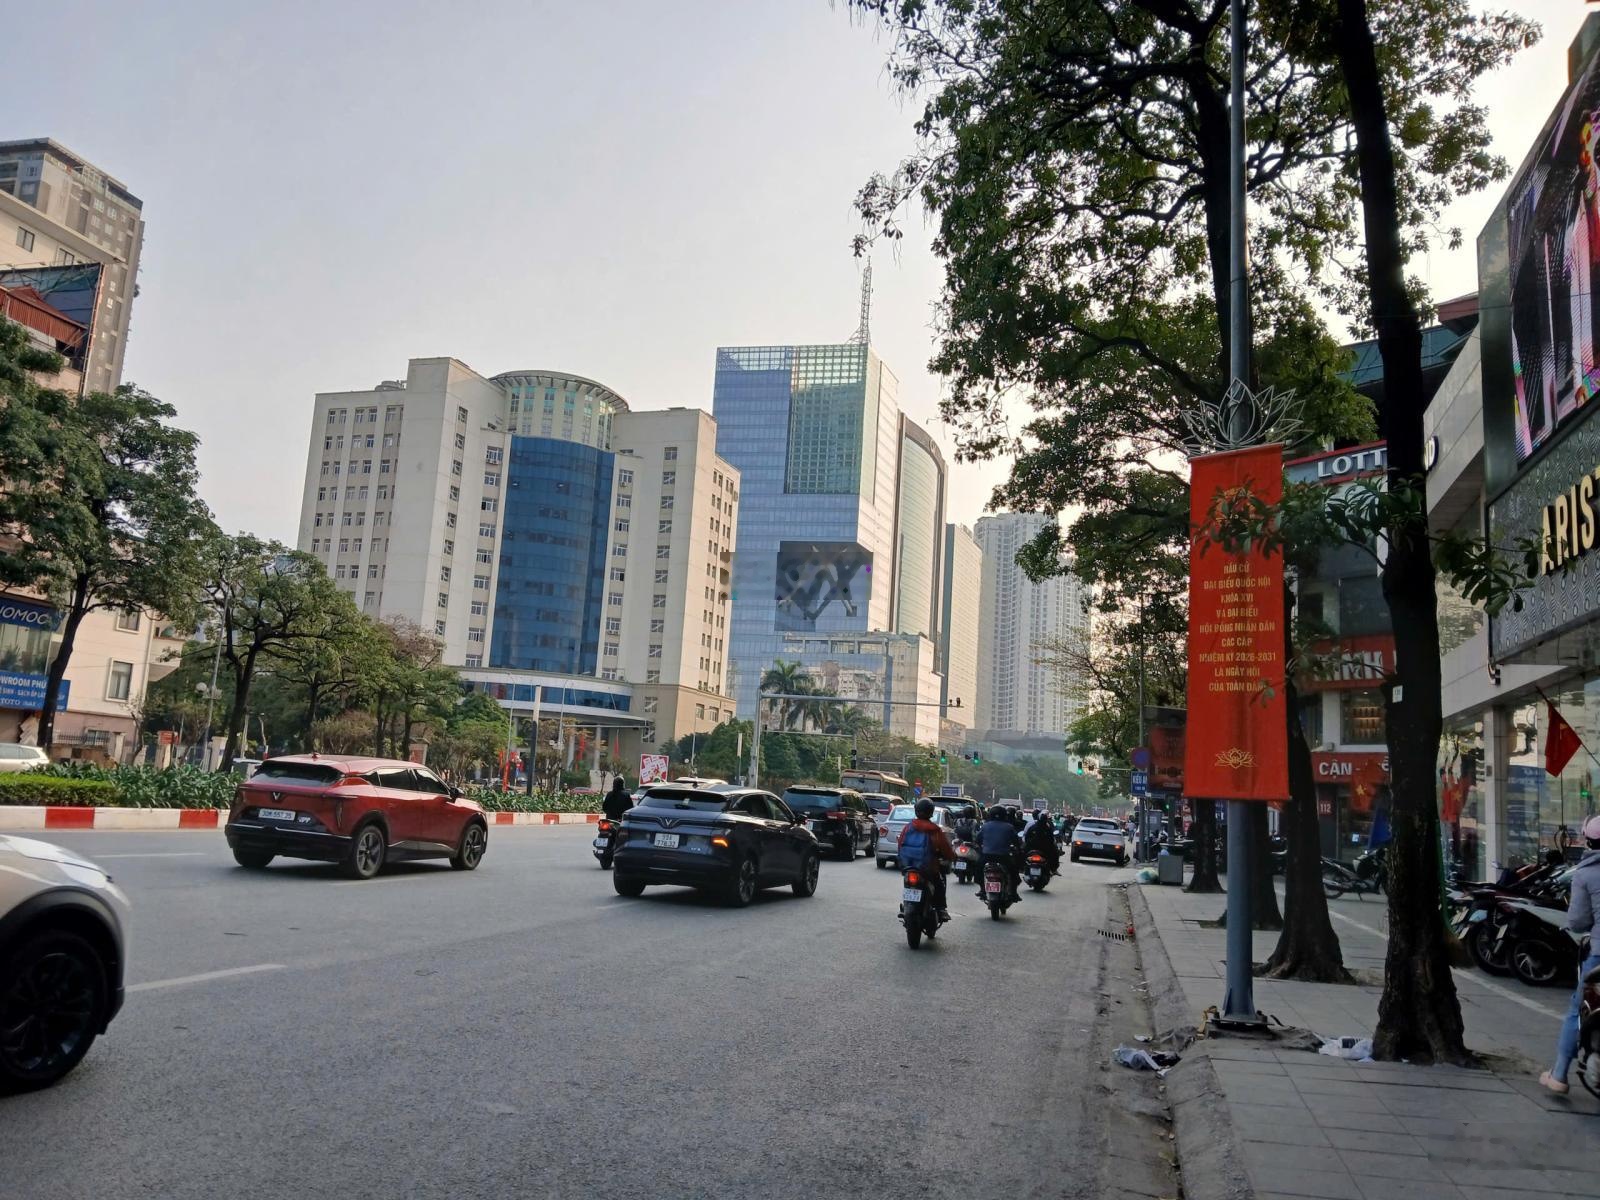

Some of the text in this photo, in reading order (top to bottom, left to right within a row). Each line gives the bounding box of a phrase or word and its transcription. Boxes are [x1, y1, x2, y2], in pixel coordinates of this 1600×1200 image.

[1541, 465, 1600, 576] ARIS
[0, 675, 30, 687] WROOM
[1319, 759, 1352, 779] CẬN
